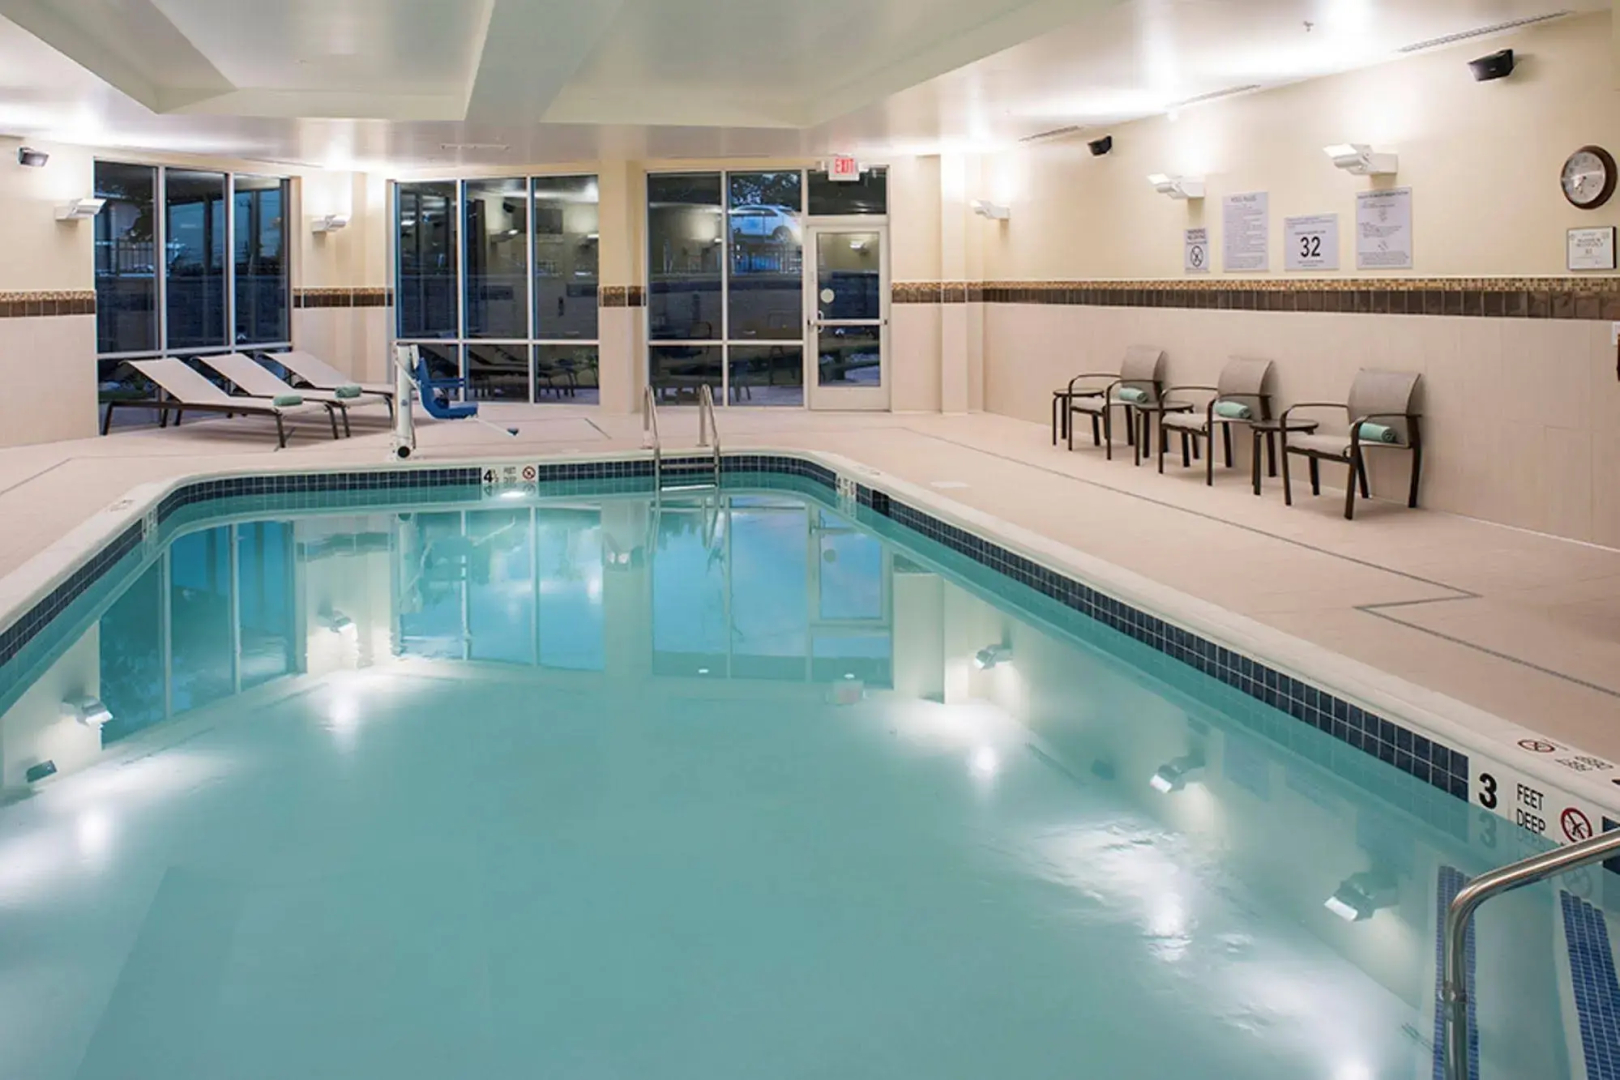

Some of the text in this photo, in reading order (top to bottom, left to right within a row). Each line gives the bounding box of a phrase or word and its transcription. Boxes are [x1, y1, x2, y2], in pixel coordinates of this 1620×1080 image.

[834, 158, 854, 174] EXIT
[1300, 235, 1321, 258] 32
[1479, 772, 1497, 809] 3
[1516, 783, 1544, 811] FEET
[1516, 808, 1546, 835] DEEP
